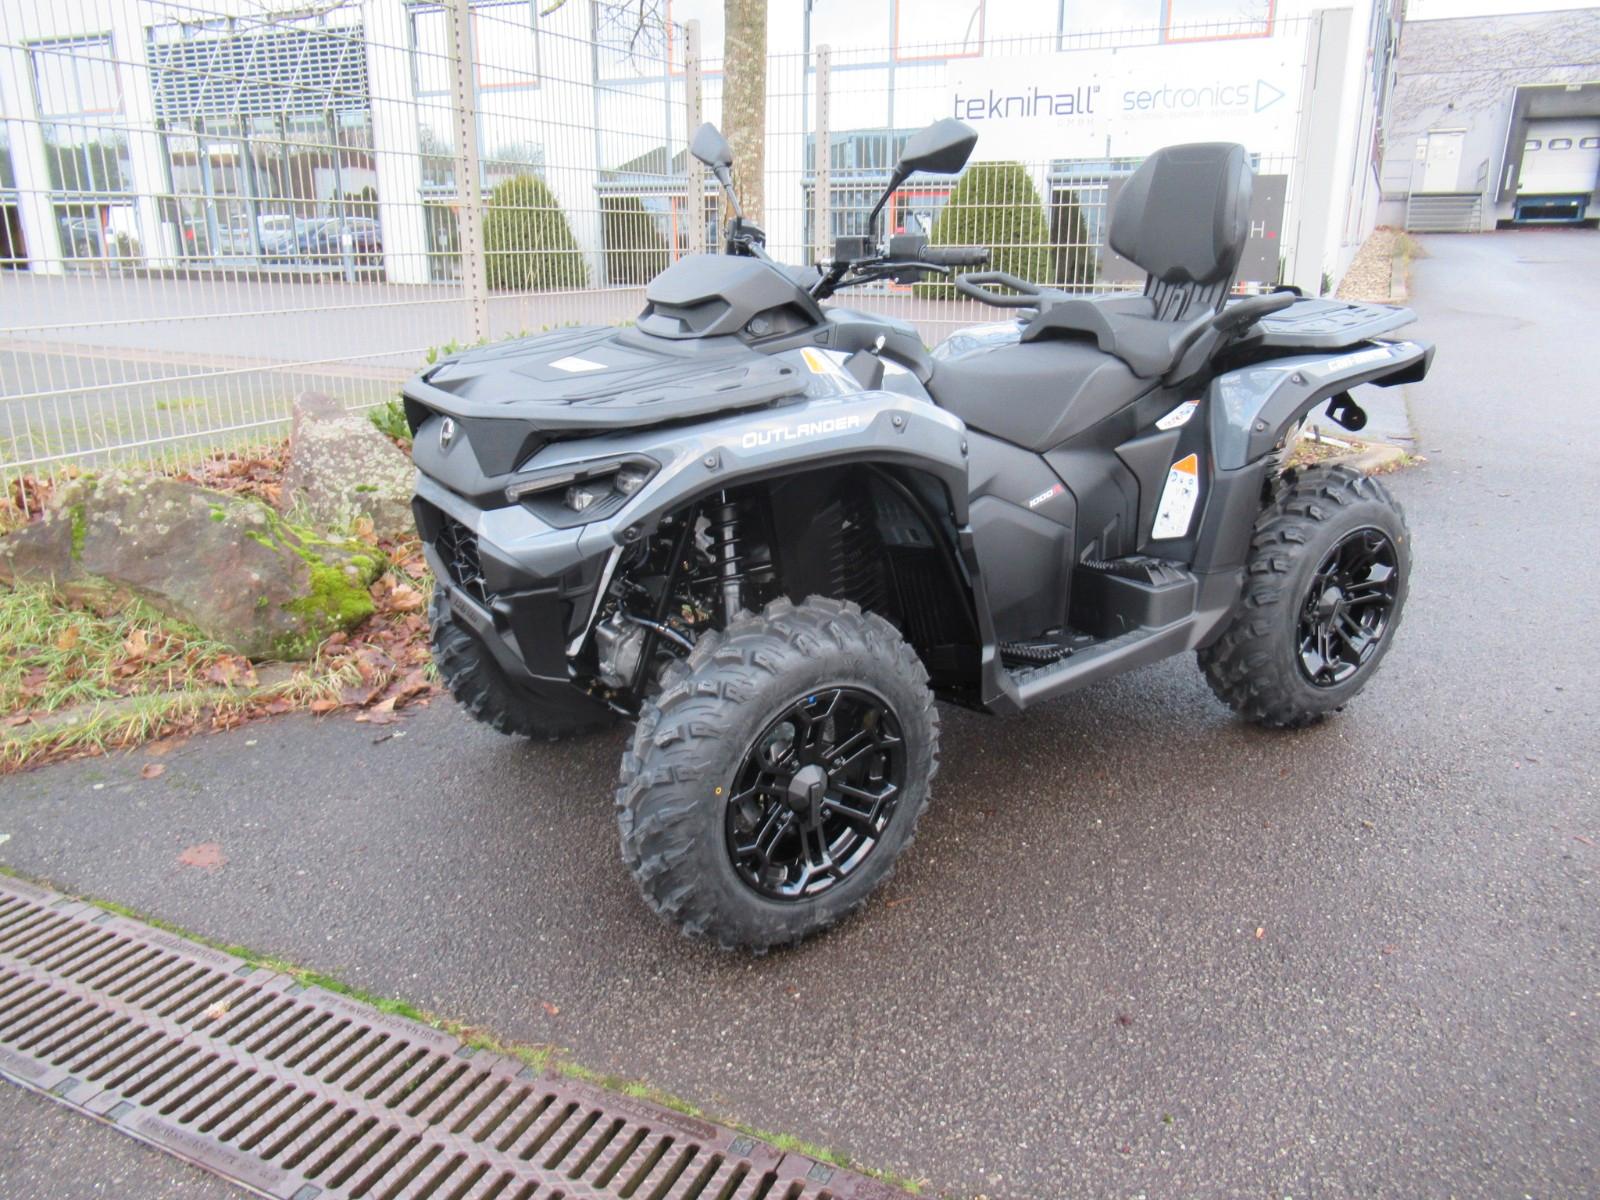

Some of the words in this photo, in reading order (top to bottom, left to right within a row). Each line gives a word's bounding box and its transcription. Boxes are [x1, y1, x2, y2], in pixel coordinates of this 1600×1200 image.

[954, 86, 1094, 121] teknihall
[1123, 81, 1249, 111] sertronics
[742, 415, 860, 449] OUTLANDER
